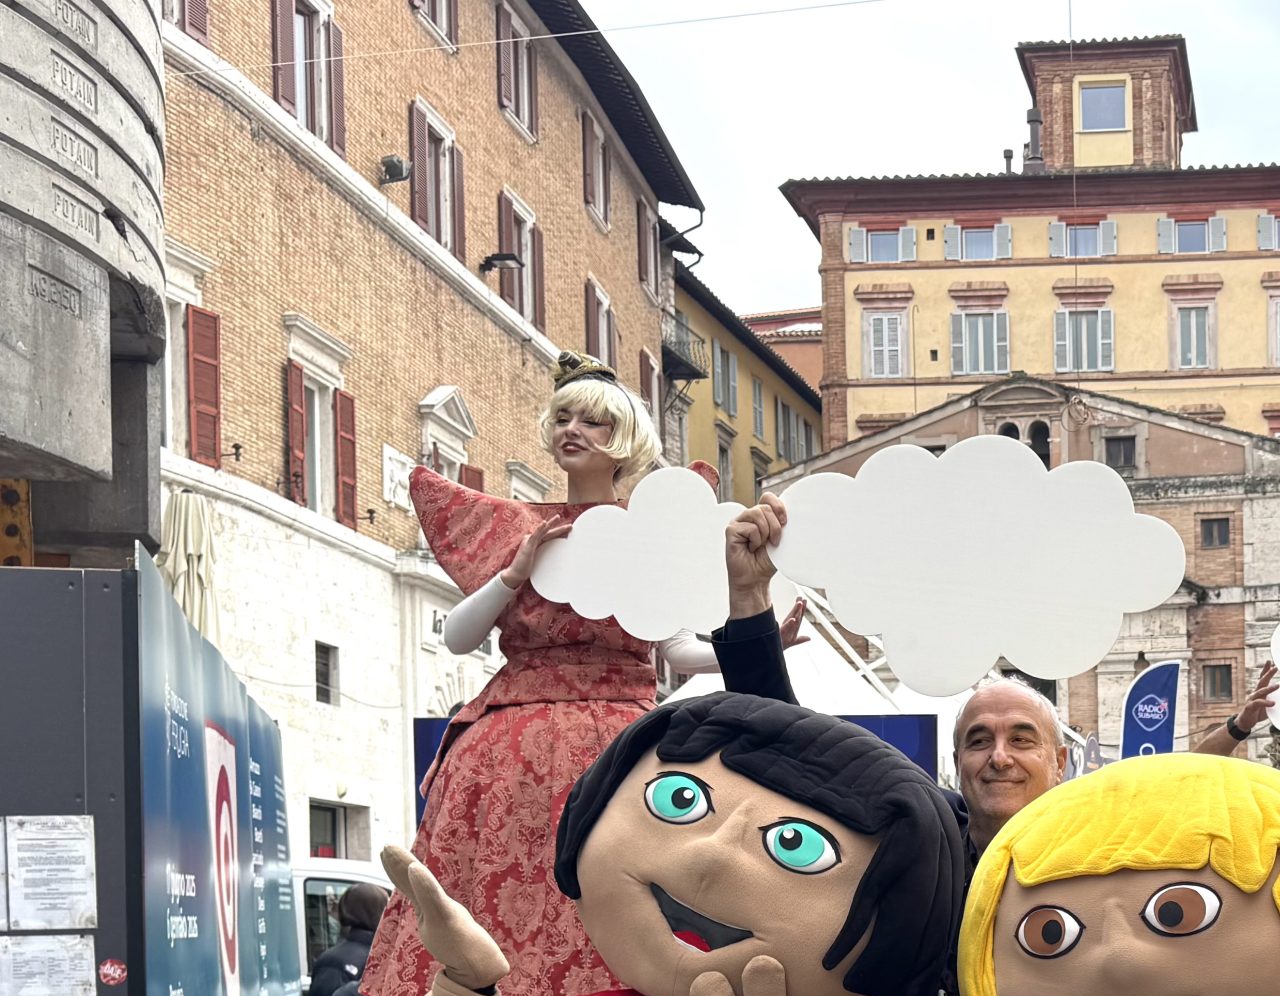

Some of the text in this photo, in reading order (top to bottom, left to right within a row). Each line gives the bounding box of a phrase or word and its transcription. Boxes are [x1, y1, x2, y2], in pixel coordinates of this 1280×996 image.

[52, 59, 94, 107] POTAIN
[52, 124, 94, 172] POTAIN
[53, 194, 95, 237] POTAIN
[1138, 704, 1163, 713] RADIO
